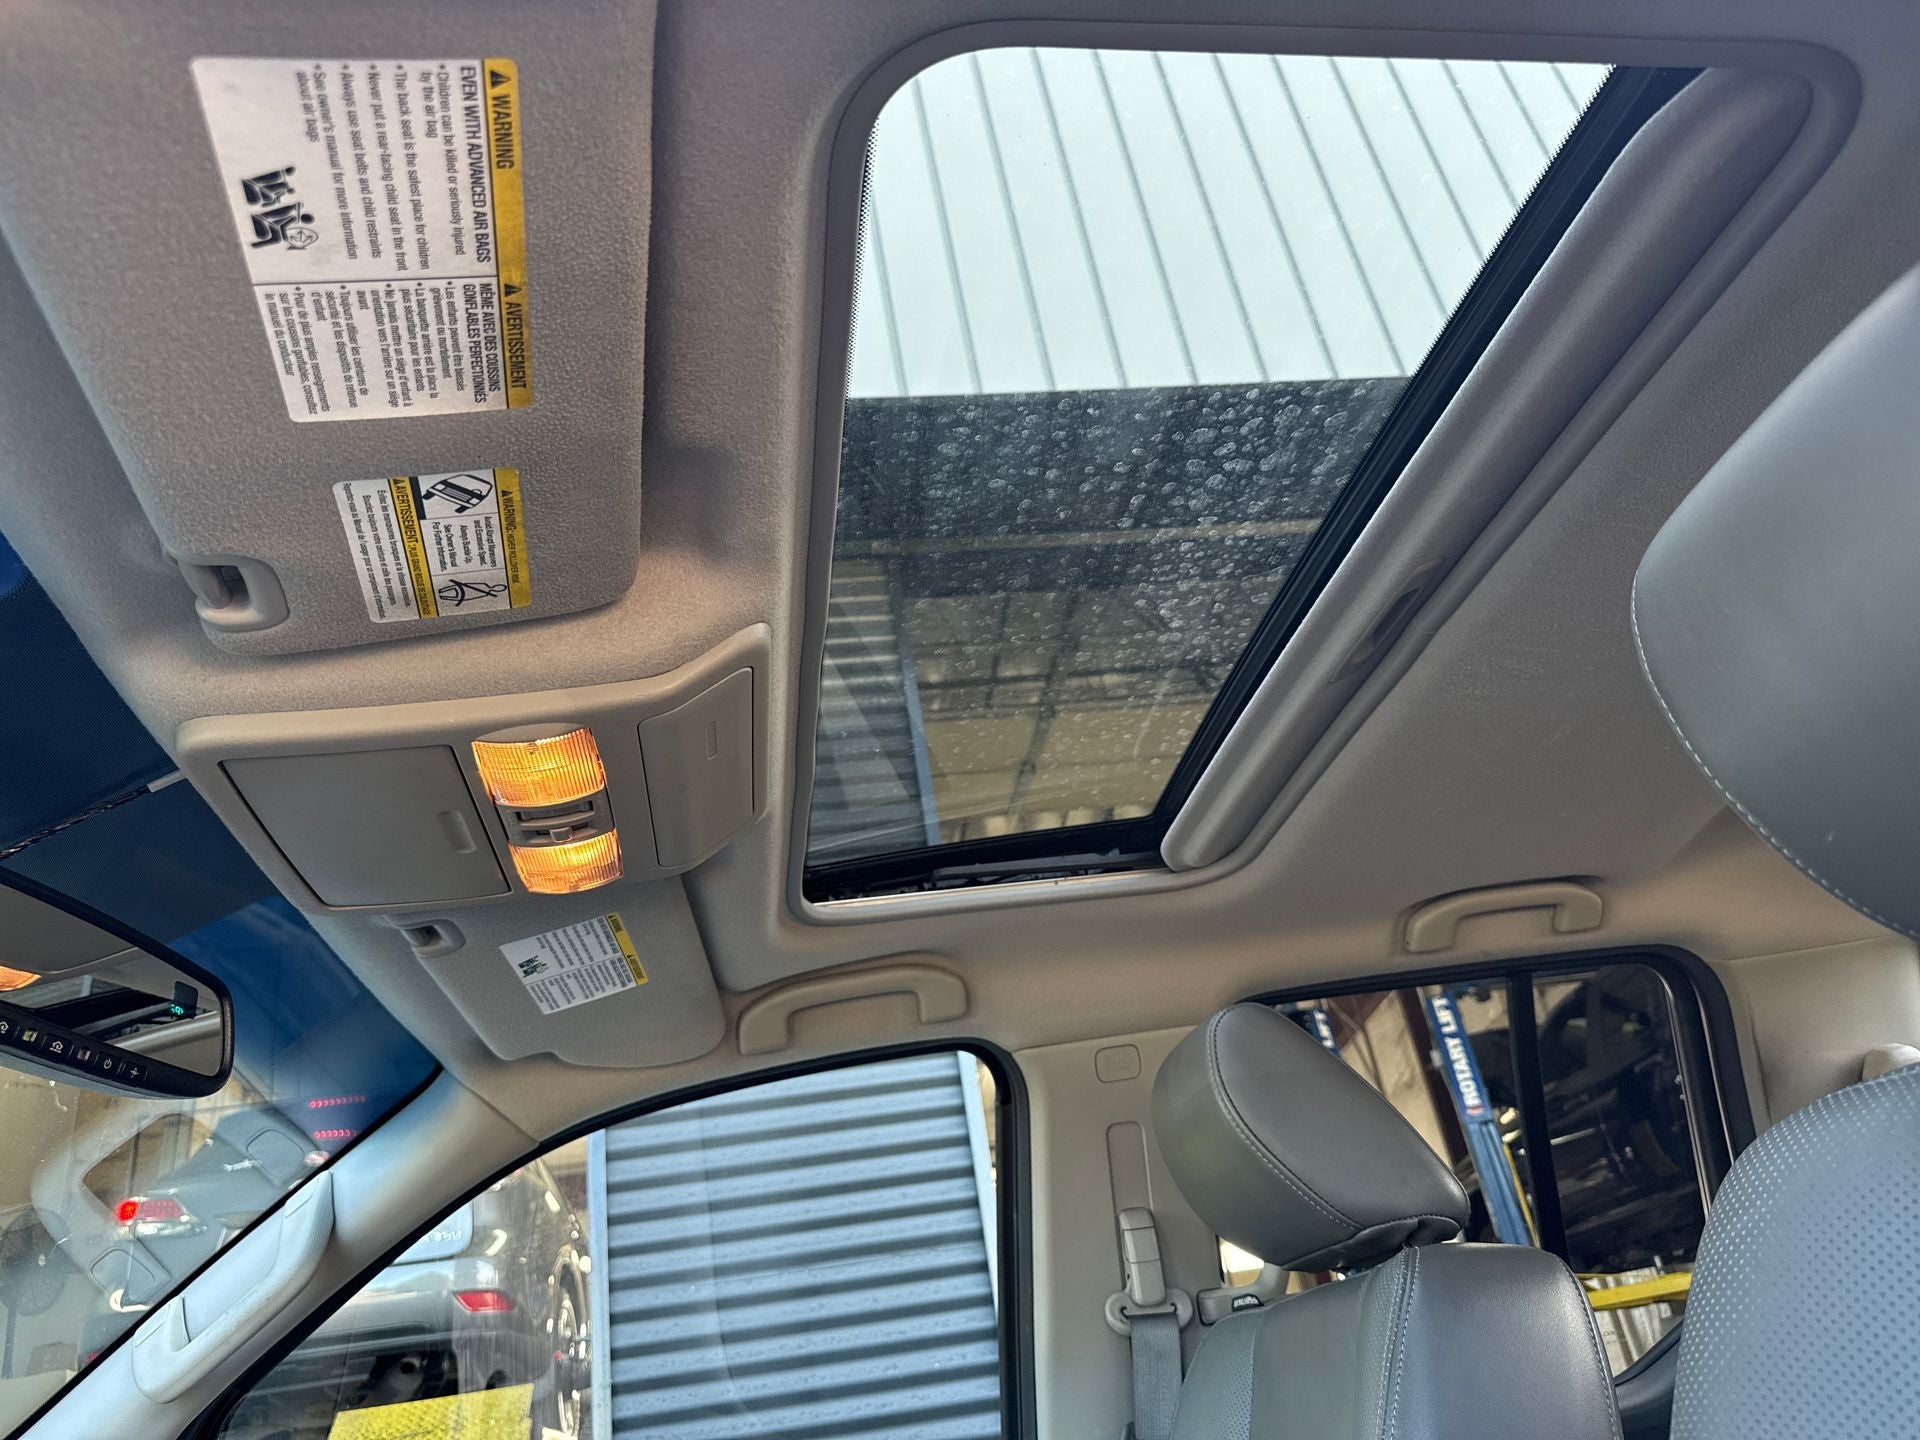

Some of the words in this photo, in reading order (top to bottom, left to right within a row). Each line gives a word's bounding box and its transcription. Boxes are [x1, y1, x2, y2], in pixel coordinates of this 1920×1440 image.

[295, 71, 313, 101] about
[312, 71, 327, 92] See
[367, 71, 381, 102] Never
[394, 71, 408, 91] The
[419, 71, 434, 84] by
[460, 66, 478, 101] EVEN
[339, 71, 356, 108] Always
[422, 85, 435, 102] the
[436, 71, 451, 113] Children
[301, 102, 316, 116] air
[369, 103, 386, 121] put
[396, 92, 412, 117] back
[424, 104, 437, 117] air
[346, 109, 359, 128] use
[400, 119, 415, 140] seat
[425, 119, 438, 139] bag
[441, 115, 452, 132] can
[463, 104, 482, 140] WITH
[305, 118, 320, 143] bags
[350, 130, 365, 151] seat
[443, 134, 455, 147] be
[491, 94, 515, 169] WARNING
[324, 135, 343, 170] manual
[376, 131, 394, 182] rear-facing
[403, 142, 416, 151] is
[353, 152, 369, 176] belts
[404, 152, 418, 168] the
[444, 149, 459, 174] killed
[331, 171, 345, 185] for
[358, 177, 373, 195] and
[407, 169, 422, 197] safest
[447, 175, 457, 185] or
[467, 142, 487, 208] ADVANCED
[335, 187, 348, 210] more
[384, 183, 399, 205] child
[361, 196, 377, 218] child
[388, 206, 402, 226] seat
[409, 198, 424, 222] place
[448, 187, 463, 225] seriously
[391, 227, 403, 235] in
[415, 223, 427, 236] for
[472, 210, 489, 231] AIR
[339, 211, 358, 260] information
[365, 219, 382, 259] restraints
[392, 236, 404, 250] the
[450, 227, 467, 255] injured
[416, 237, 430, 270] children
[474, 232, 491, 263] BAGS
[395, 251, 409, 271] front
[462, 283, 481, 339] GONFLABLES
[482, 311, 496, 334] AVEC
[484, 335, 498, 352] DES
[505, 301, 527, 389] AVERTISSEMENT
[485, 352, 501, 392] COUSSINS
[394, 485, 419, 544] AVERTISSEMENT
[1431, 996, 1458, 1035] LIFT
[1313, 1009, 1336, 1049] LIFT
[1444, 1036, 1483, 1109] ROTARY
